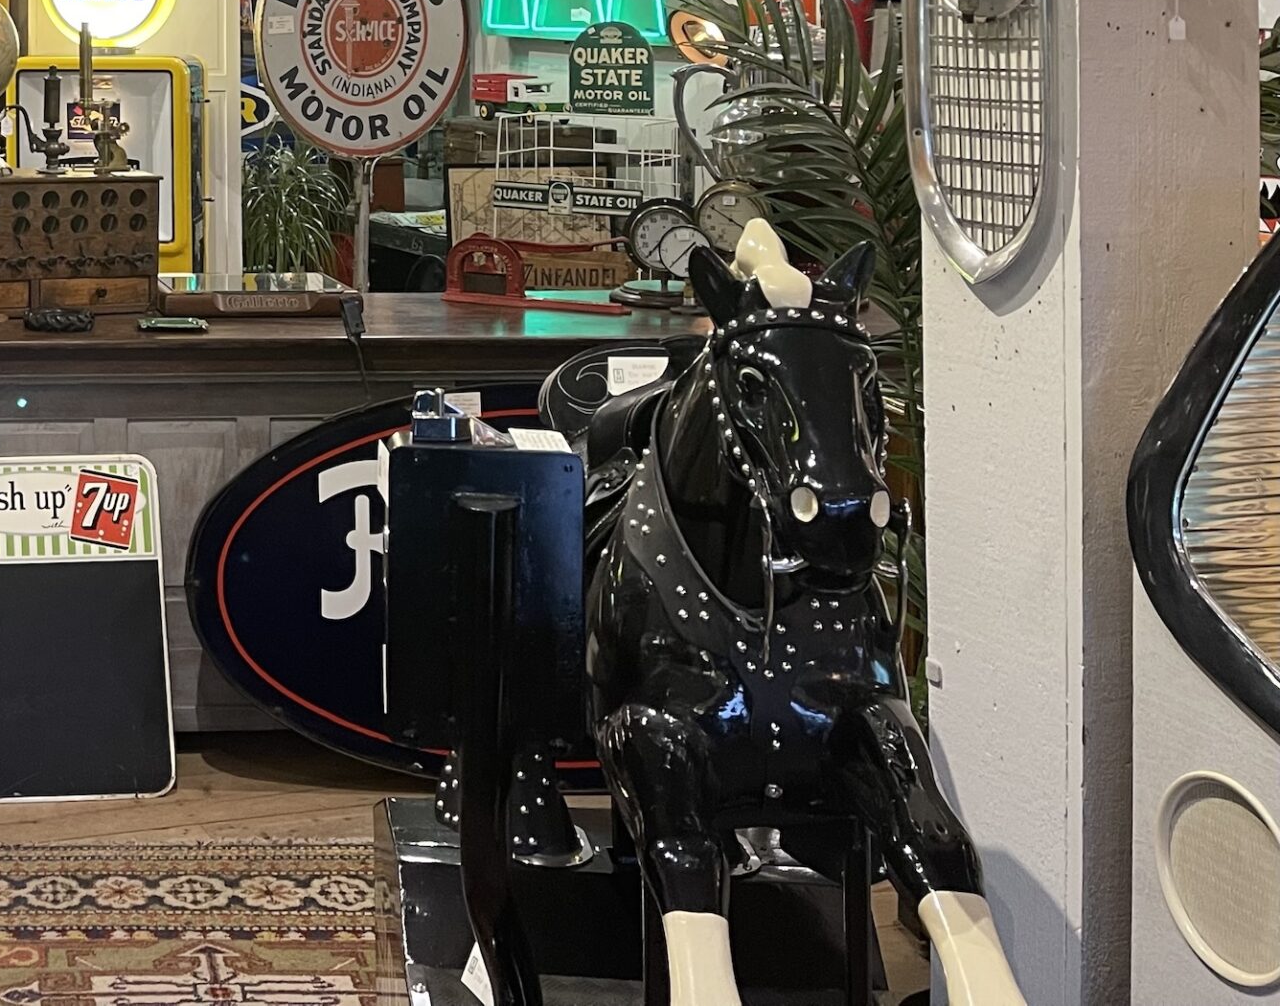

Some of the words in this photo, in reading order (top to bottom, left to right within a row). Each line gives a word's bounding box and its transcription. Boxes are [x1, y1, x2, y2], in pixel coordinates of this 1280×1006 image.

[335, 20, 397, 42] SERVICE
[573, 47, 649, 67] QUAKER
[331, 75, 397, 99] (INDIANA)
[580, 68, 643, 86] STATE
[278, 65, 391, 142] MOTOR
[402, 66, 450, 121] OIL
[574, 89, 623, 100] MOTOR
[628, 90, 651, 101] OIL
[494, 187, 543, 203] QUAKER
[575, 194, 613, 208] STATE
[616, 197, 638, 210] OIL
[34, 484, 72, 520] up"
